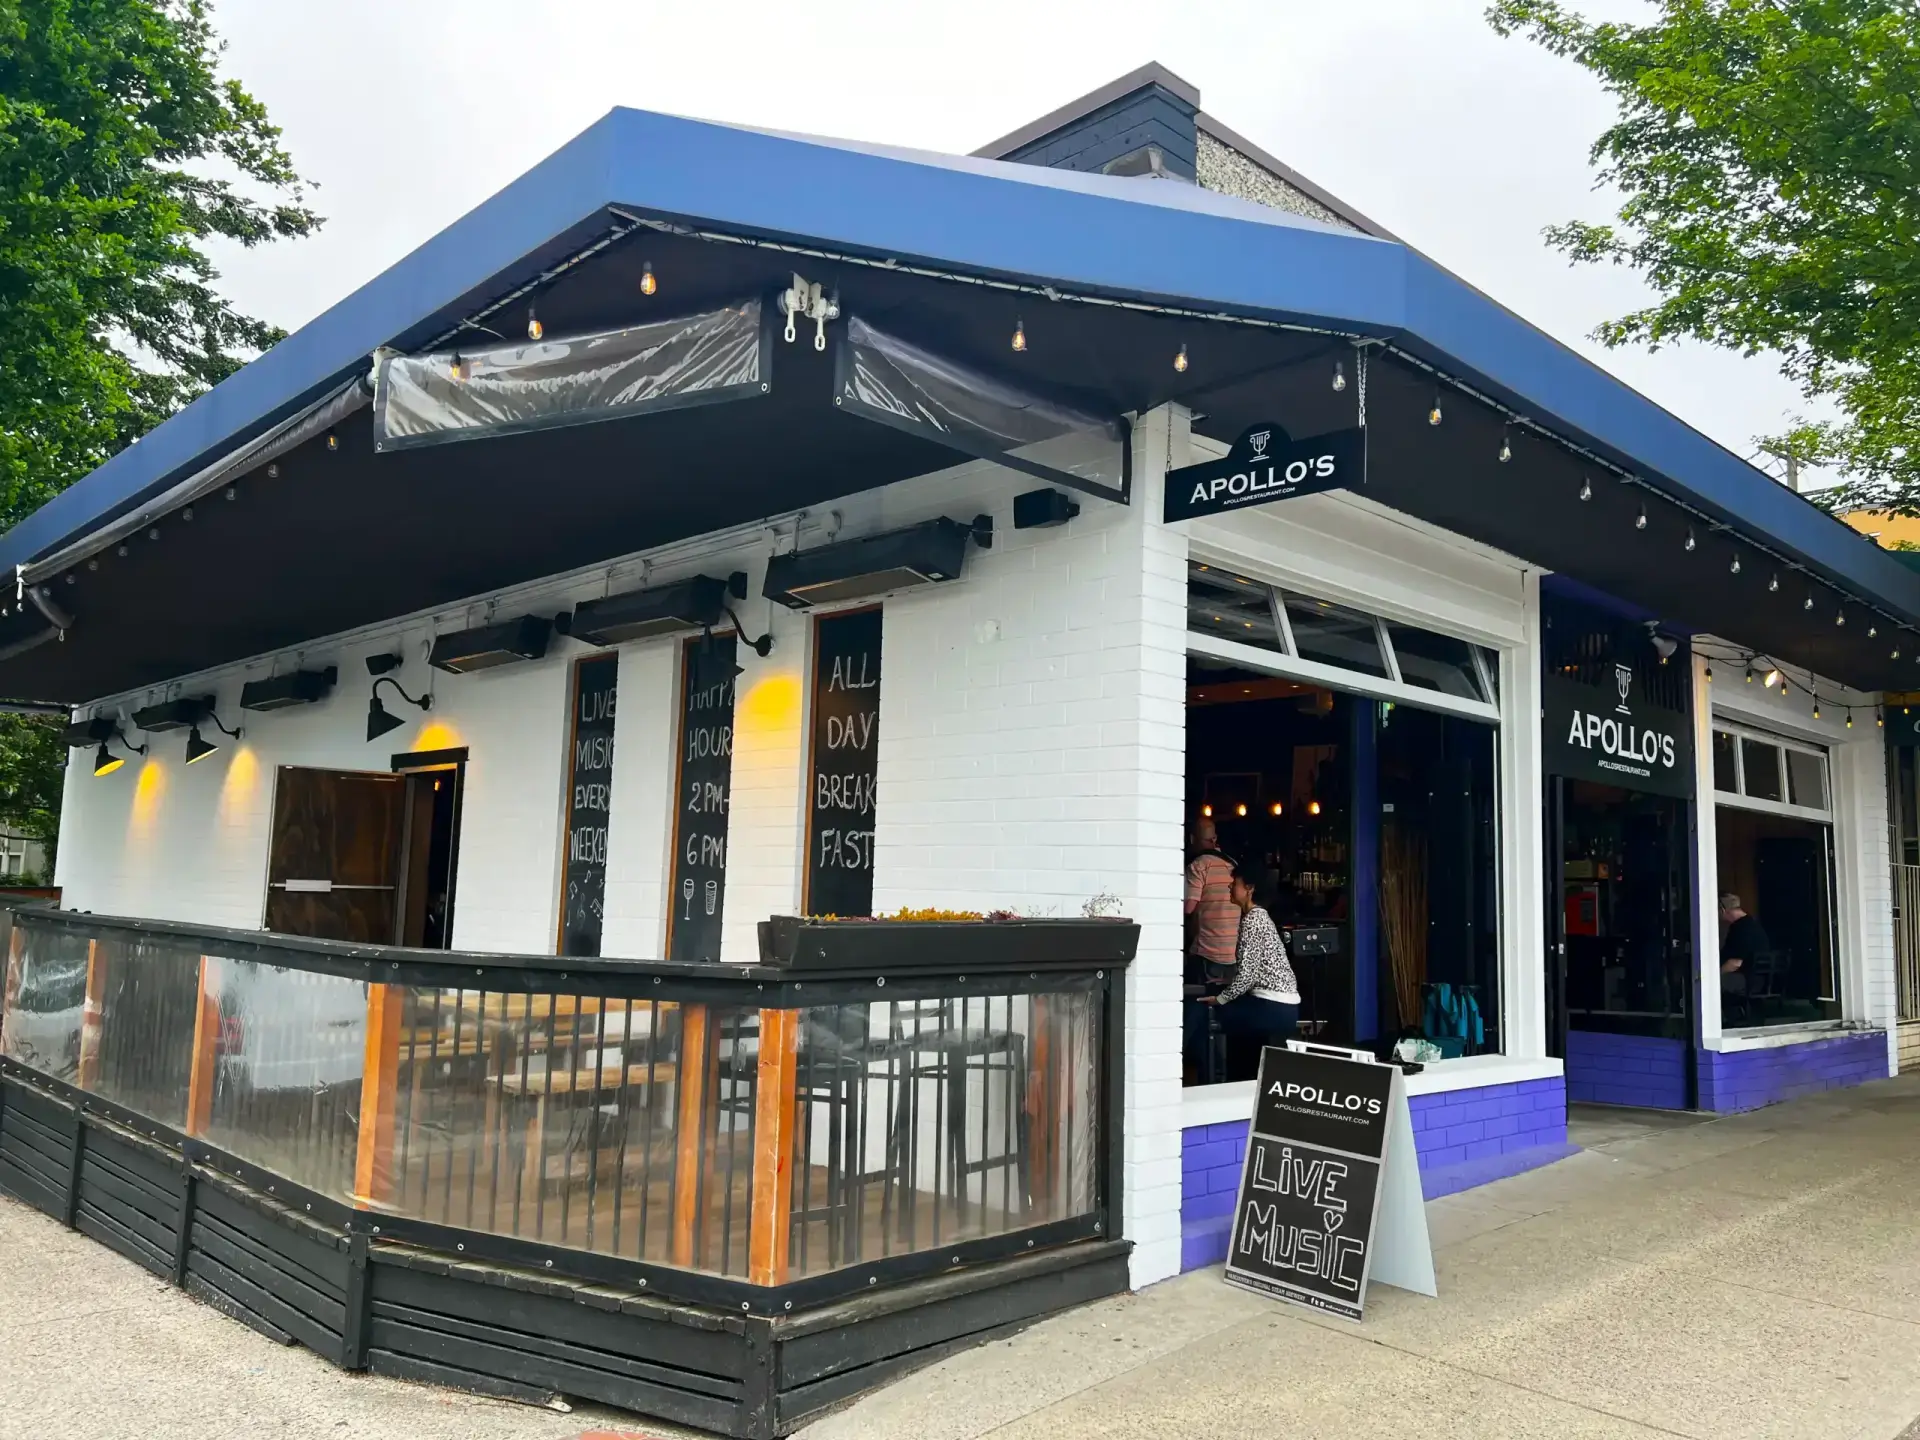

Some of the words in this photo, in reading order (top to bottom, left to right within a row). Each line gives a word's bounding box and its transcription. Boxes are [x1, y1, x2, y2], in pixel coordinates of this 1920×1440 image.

[1190, 455, 1335, 504] APOLLO'S
[1223, 487, 1296, 505] APOLLOSRESTAURANT.COM
[828, 652, 876, 692] ALL
[582, 688, 617, 722] LIVE
[687, 726, 732, 762] HOUR
[828, 711, 876, 751] DAY
[1568, 710, 1675, 768] APOLLO'S
[576, 737, 614, 771] MUSIC
[1598, 759, 1651, 777] APOLLOSRESTAURANT.COM
[688, 781, 701, 813] 2
[818, 773, 877, 816] BREAK
[687, 832, 697, 865] 6
[701, 834, 725, 868] PM
[820, 828, 875, 869] FAST
[1268, 1081, 1382, 1114] APOLLO'S
[1274, 1103, 1370, 1125] APOLLOSRESTAURANT.COM
